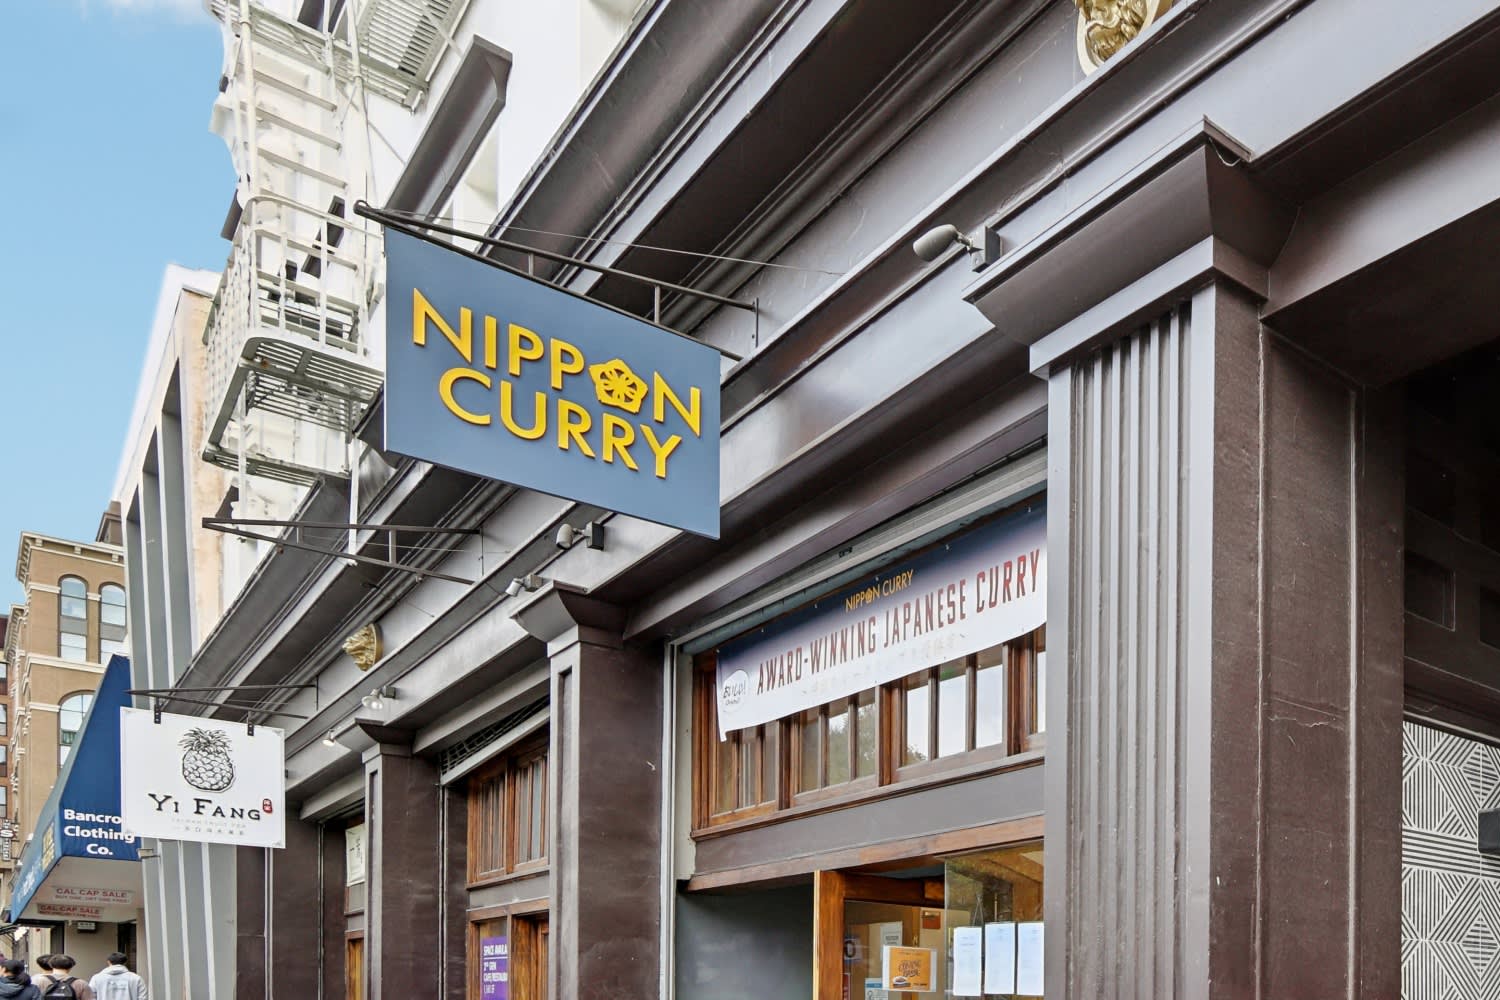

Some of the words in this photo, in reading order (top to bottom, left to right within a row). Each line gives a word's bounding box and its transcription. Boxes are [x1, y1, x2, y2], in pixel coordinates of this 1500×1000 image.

[438, 367, 682, 478] CURRY
[883, 569, 913, 597] CURRY
[757, 616, 876, 695] AWARD-WINNING
[883, 579, 966, 648] JAPANESE
[976, 549, 1040, 613] CURRY
[64, 808, 122, 824] Bancro
[64, 825, 135, 843] Clothing
[86, 843, 113, 855] Co.
[102, 890, 127, 898] SALE
